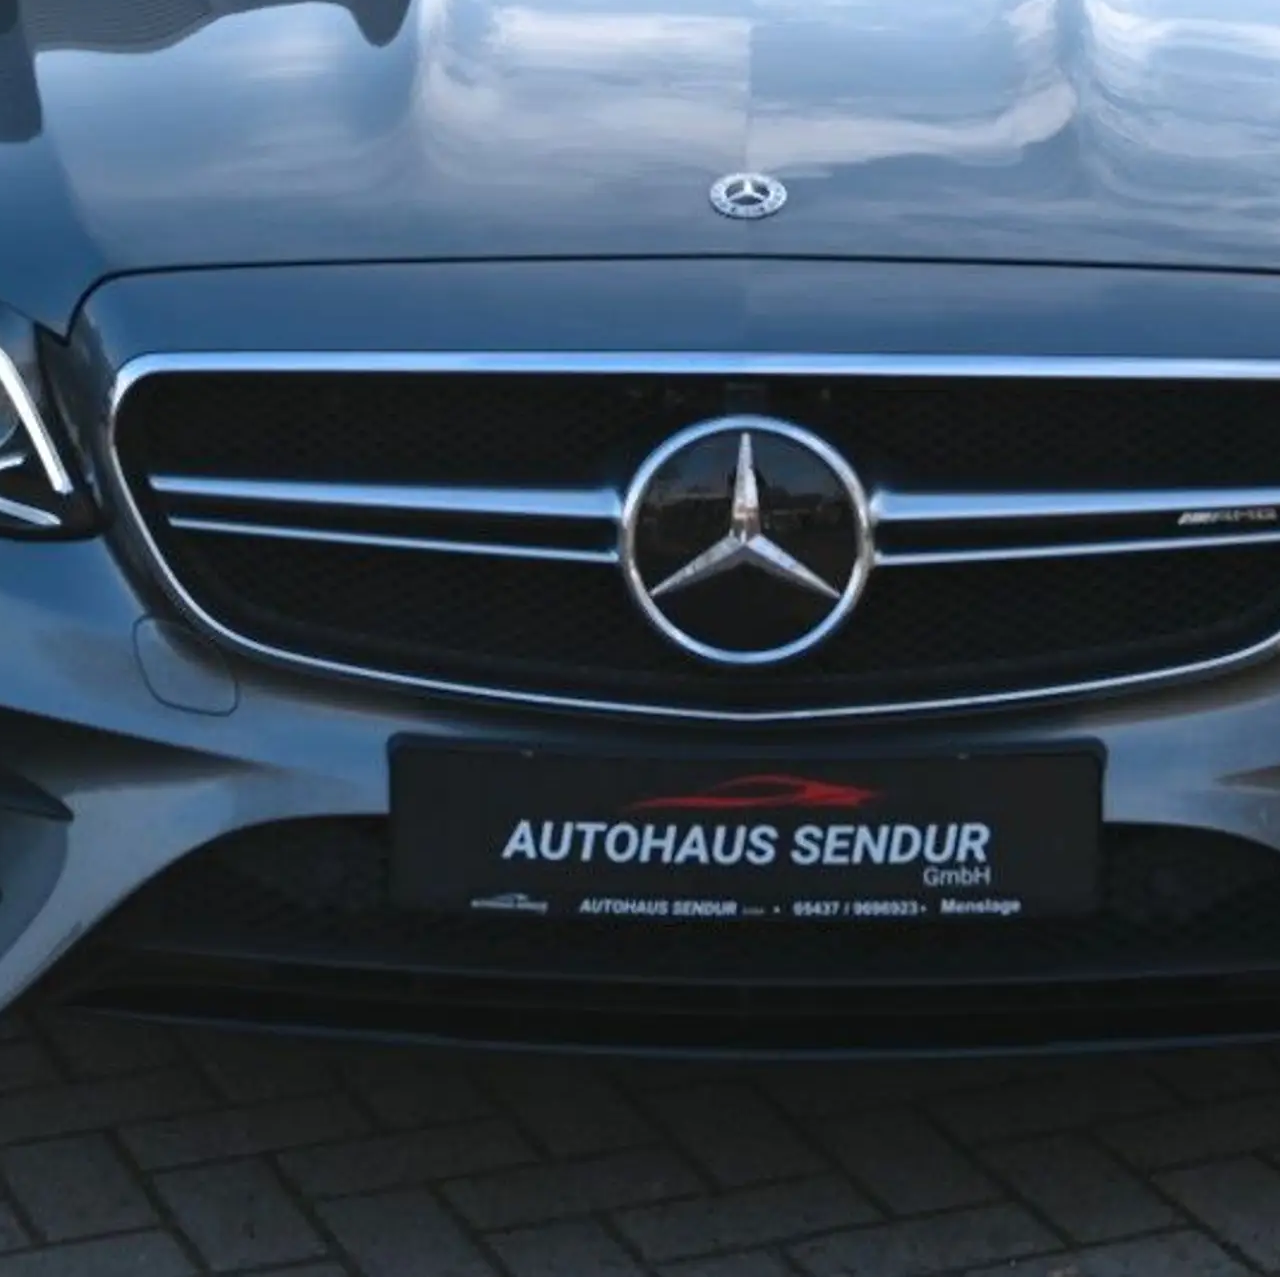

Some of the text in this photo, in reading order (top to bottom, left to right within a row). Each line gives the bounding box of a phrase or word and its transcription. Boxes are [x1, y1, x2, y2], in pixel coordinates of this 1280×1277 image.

[502, 819, 991, 865] AUTOHAUS SENDUR
[923, 866, 991, 887] GmbH
[579, 897, 669, 916] AUTOHAUS
[672, 899, 738, 917] SENDUR
